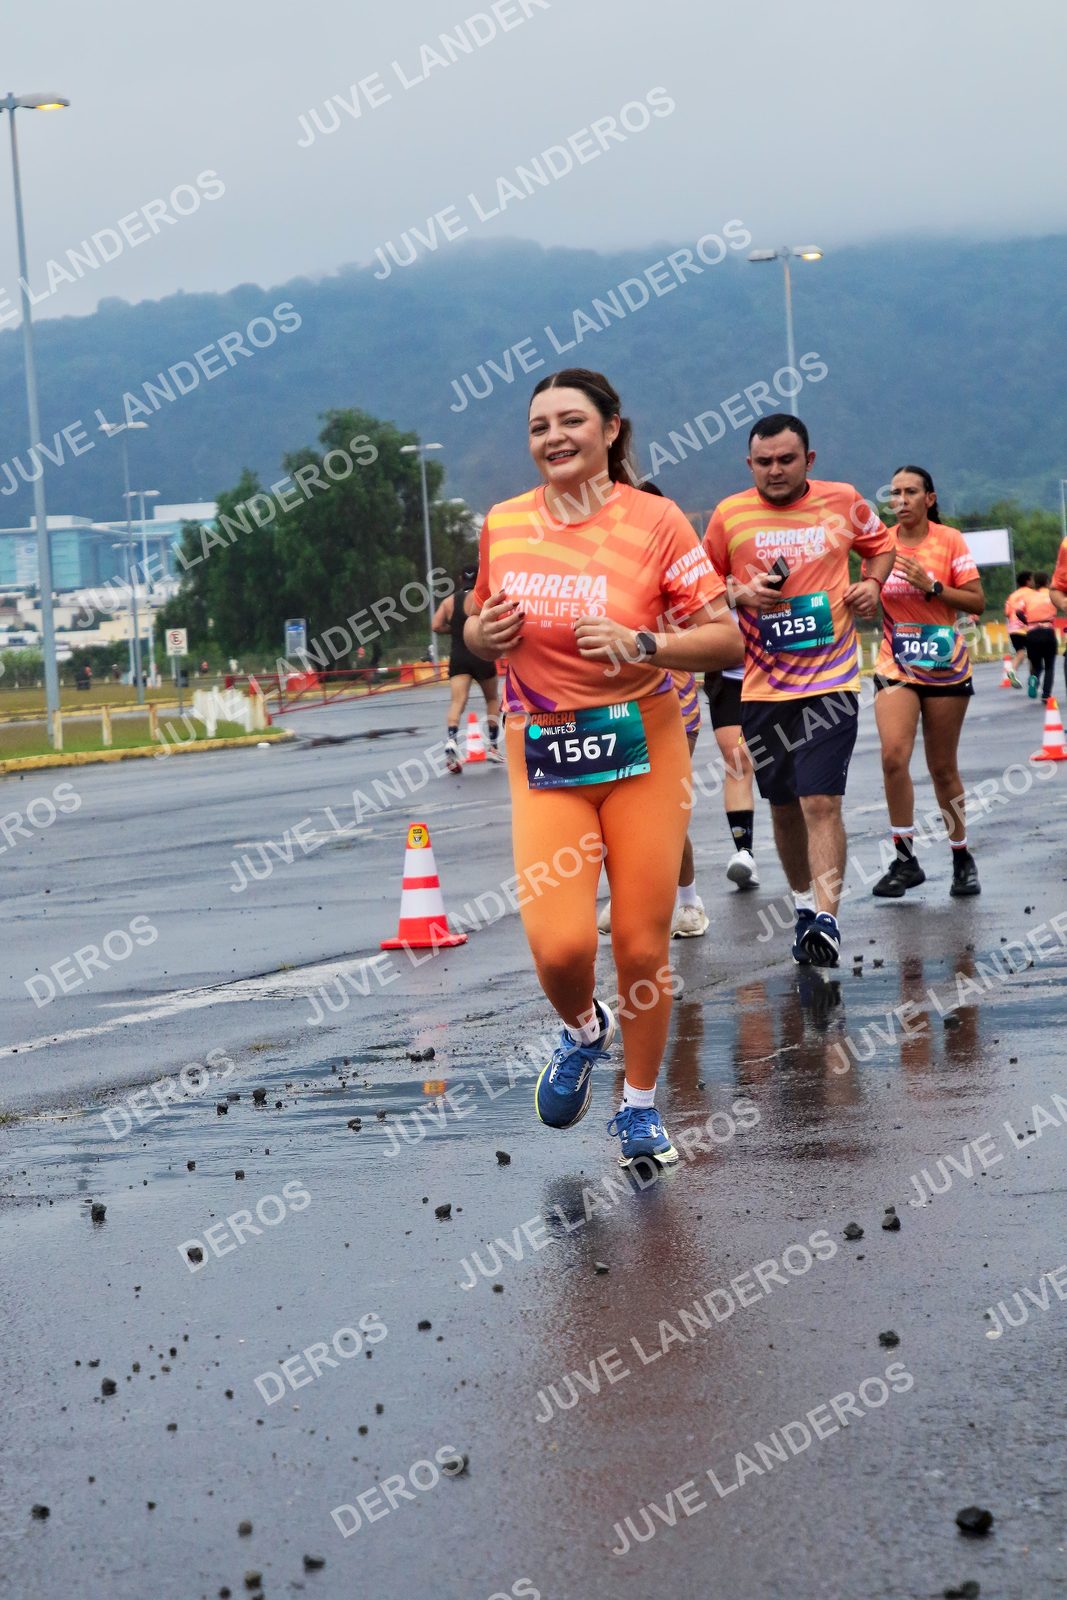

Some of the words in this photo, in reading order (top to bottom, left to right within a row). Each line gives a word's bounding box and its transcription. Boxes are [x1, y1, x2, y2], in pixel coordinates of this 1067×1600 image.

[755, 526, 826, 548] CARRERA
[501, 571, 607, 599] CARRERA
[503, 598, 580, 618] MNILIFE
[811, 595, 824, 608] 10K
[771, 615, 817, 637] 1253
[902, 640, 939, 655] 1012
[530, 711, 576, 726] CARRERA
[608, 702, 630, 720] 10K
[538, 725, 565, 736] MNILIFE
[547, 732, 617, 763] 1567
